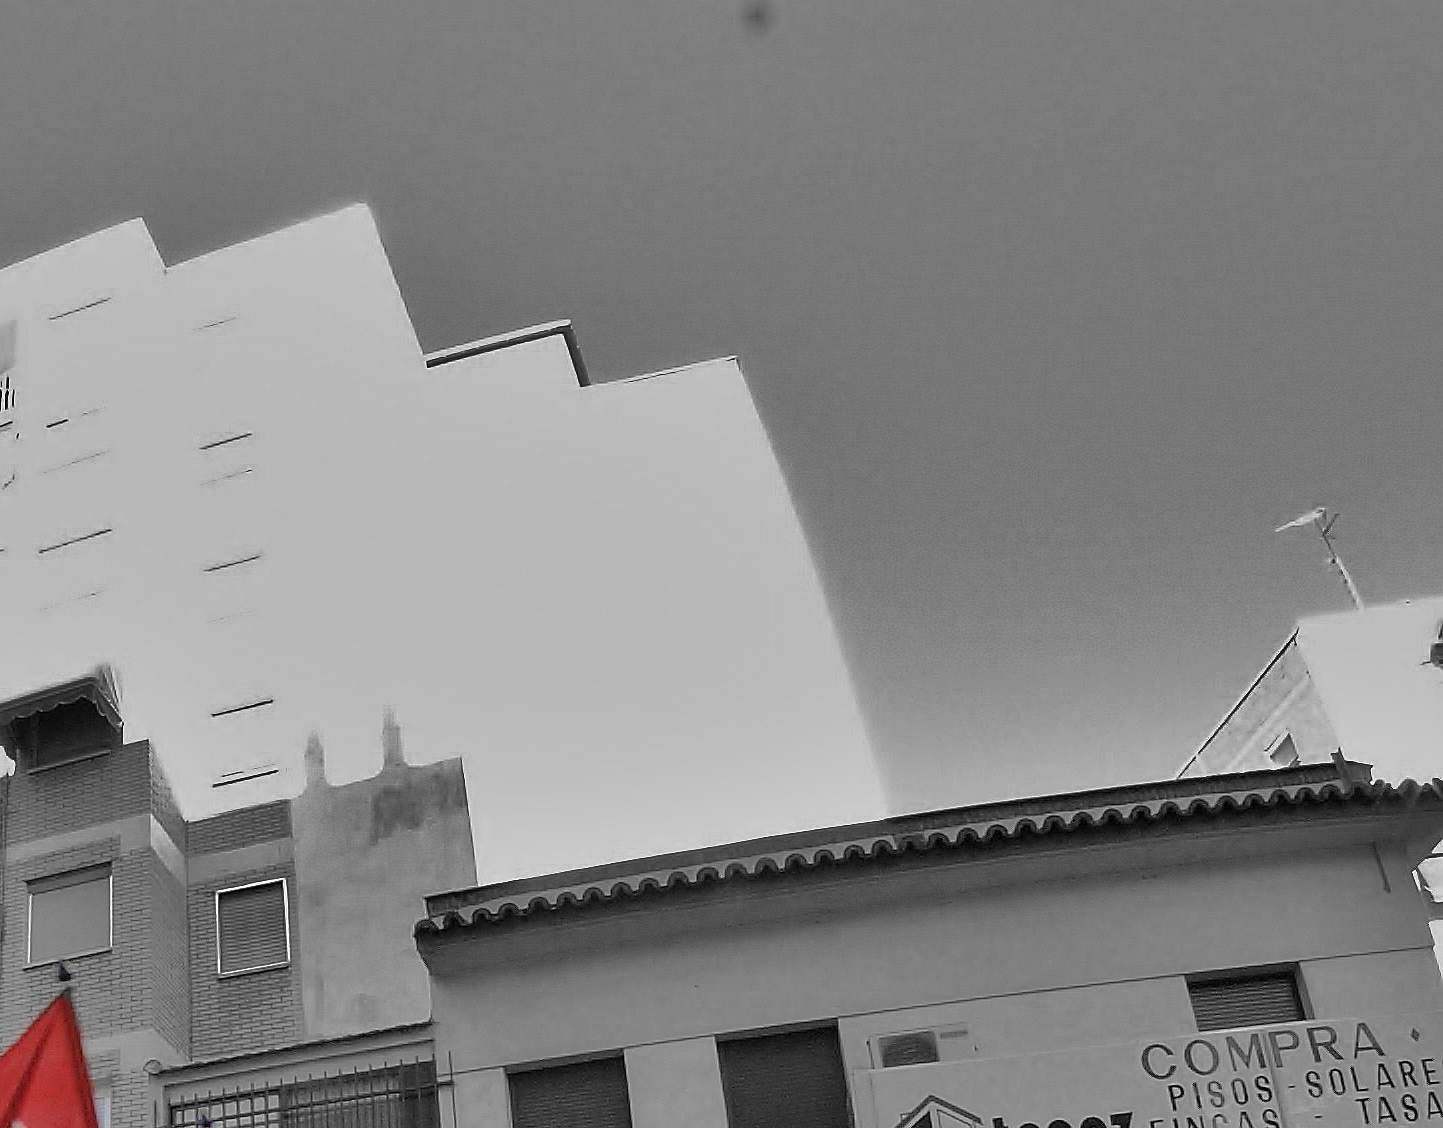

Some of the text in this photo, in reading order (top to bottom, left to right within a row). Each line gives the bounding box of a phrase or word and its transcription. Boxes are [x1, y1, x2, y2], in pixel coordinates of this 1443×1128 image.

[1141, 1022, 1387, 1081] COMPRA
[1168, 1075, 1274, 1112] PISOS
[1305, 1058, 1443, 1098] SOLARE
